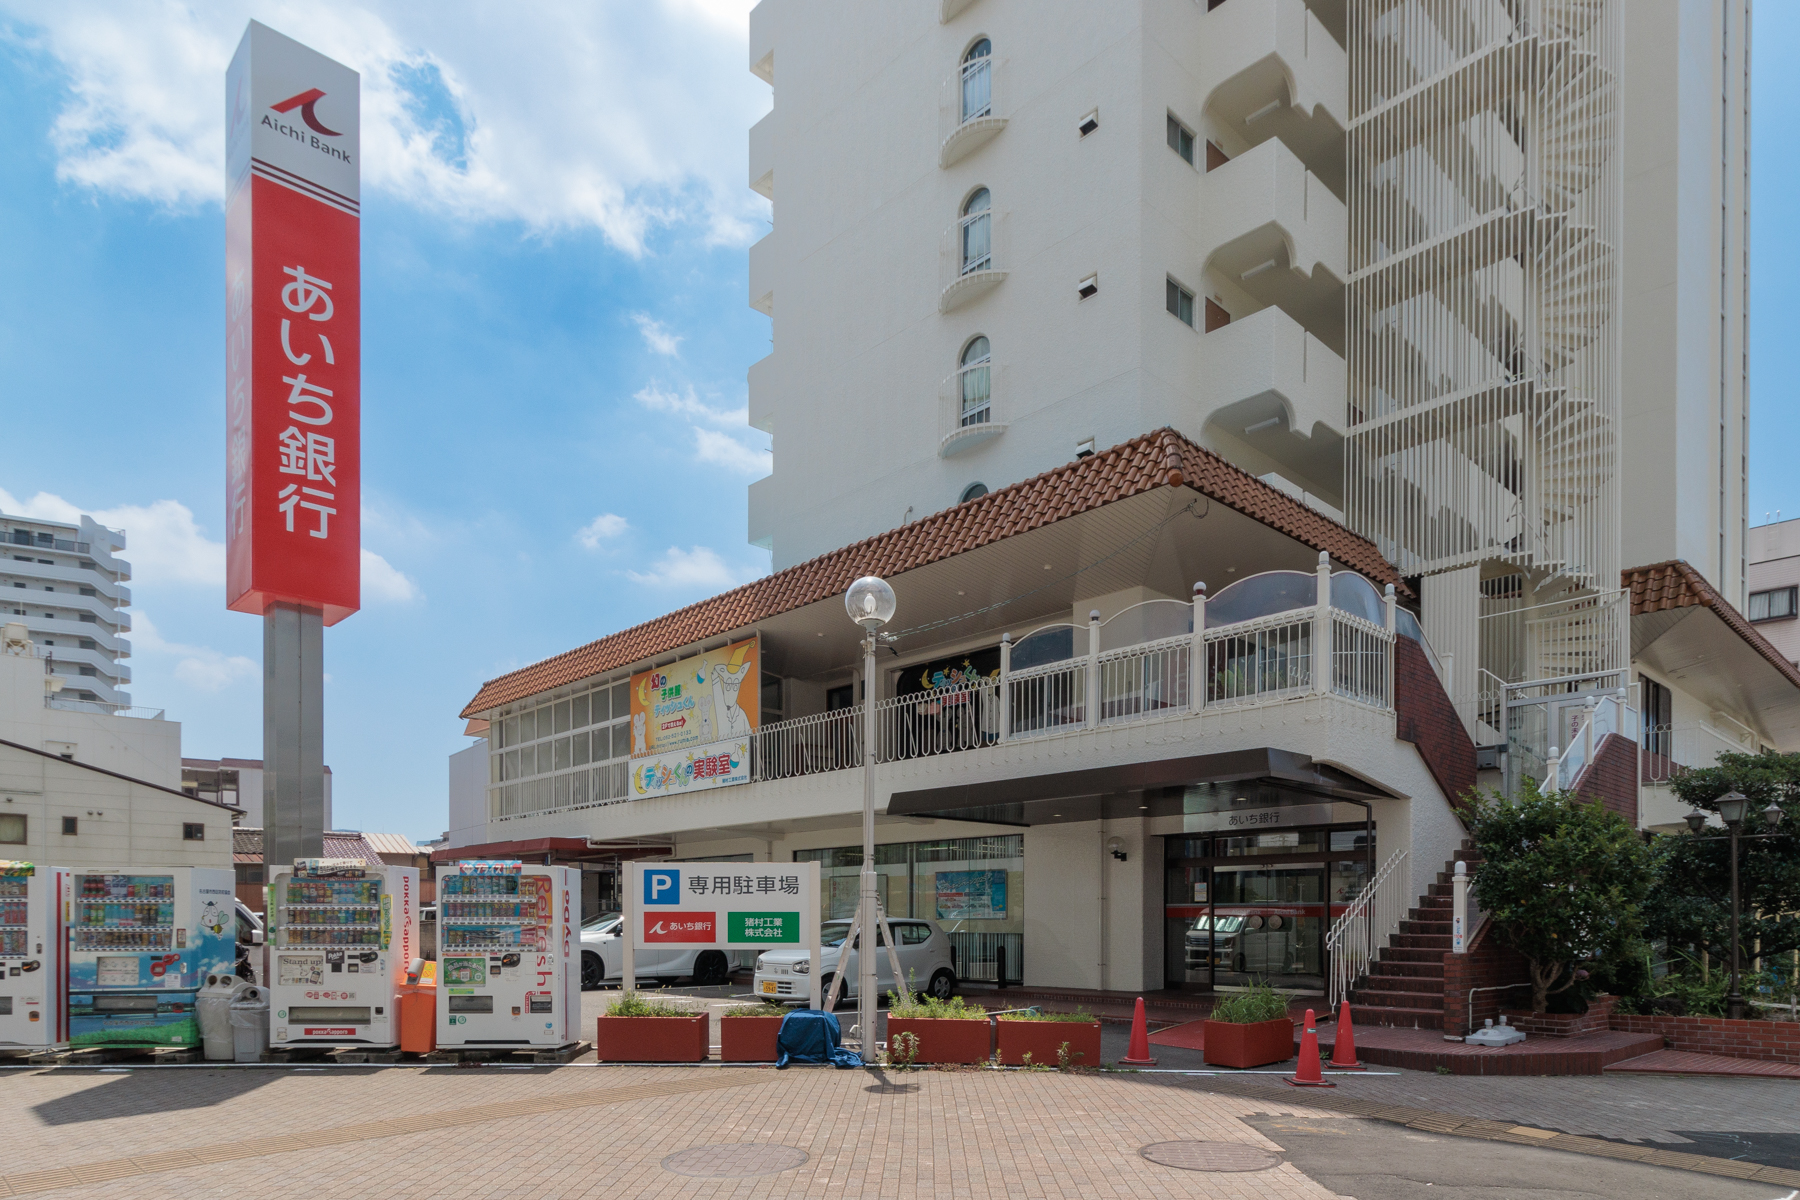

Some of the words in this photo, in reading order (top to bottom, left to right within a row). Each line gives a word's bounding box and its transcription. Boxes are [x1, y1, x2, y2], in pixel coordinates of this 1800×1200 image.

[261, 114, 305, 142] Aichi
[310, 135, 351, 164] Bank
[278, 264, 337, 540] あいち銀行
[1228, 811, 1280, 826] あいち銀行
[652, 874, 672, 900] P
[688, 875, 800, 895] 専用駐車場
[669, 921, 712, 931] あいち銀行
[744, 918, 783, 927] 猪村工業
[744, 928, 783, 937] 株式会社
[310, 958, 324, 966] up!
